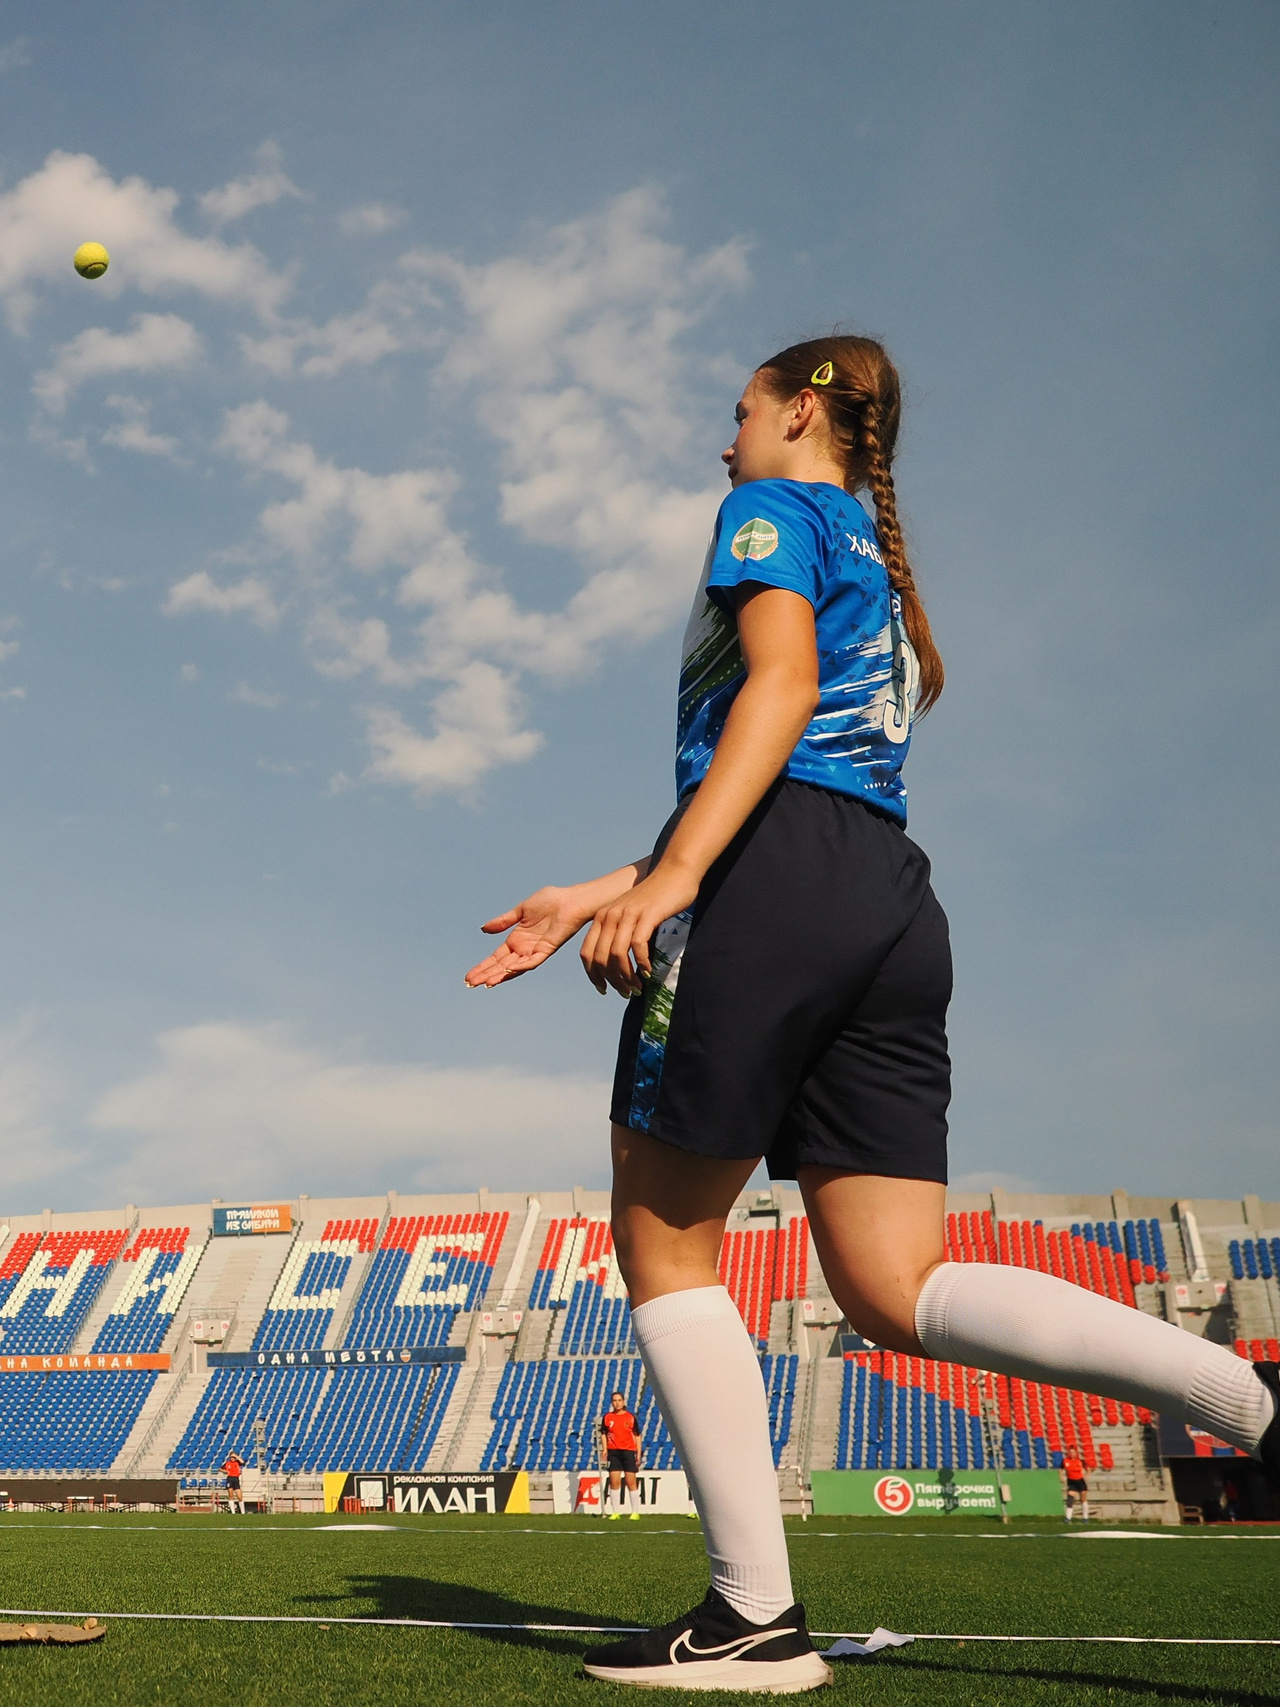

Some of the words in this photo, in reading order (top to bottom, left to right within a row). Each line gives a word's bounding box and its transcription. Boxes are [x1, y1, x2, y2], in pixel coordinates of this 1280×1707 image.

[226, 1209, 279, 1220] ПРЯМИКОМ
[226, 1220, 240, 1231] ИЗ
[241, 1219, 279, 1230] СИБИРИ
[42, 1356, 133, 1369] КОМАНДА
[257, 1351, 310, 1366] ОДНА
[325, 1350, 395, 1363] МЕЧТА
[393, 1475, 445, 1485] рекламная
[447, 1475, 495, 1484] компания
[885, 1479, 904, 1508] 5
[915, 1483, 994, 1496] Пятёрочка
[393, 1487, 496, 1513] ИЛАН
[917, 1497, 996, 1510] выручает!
